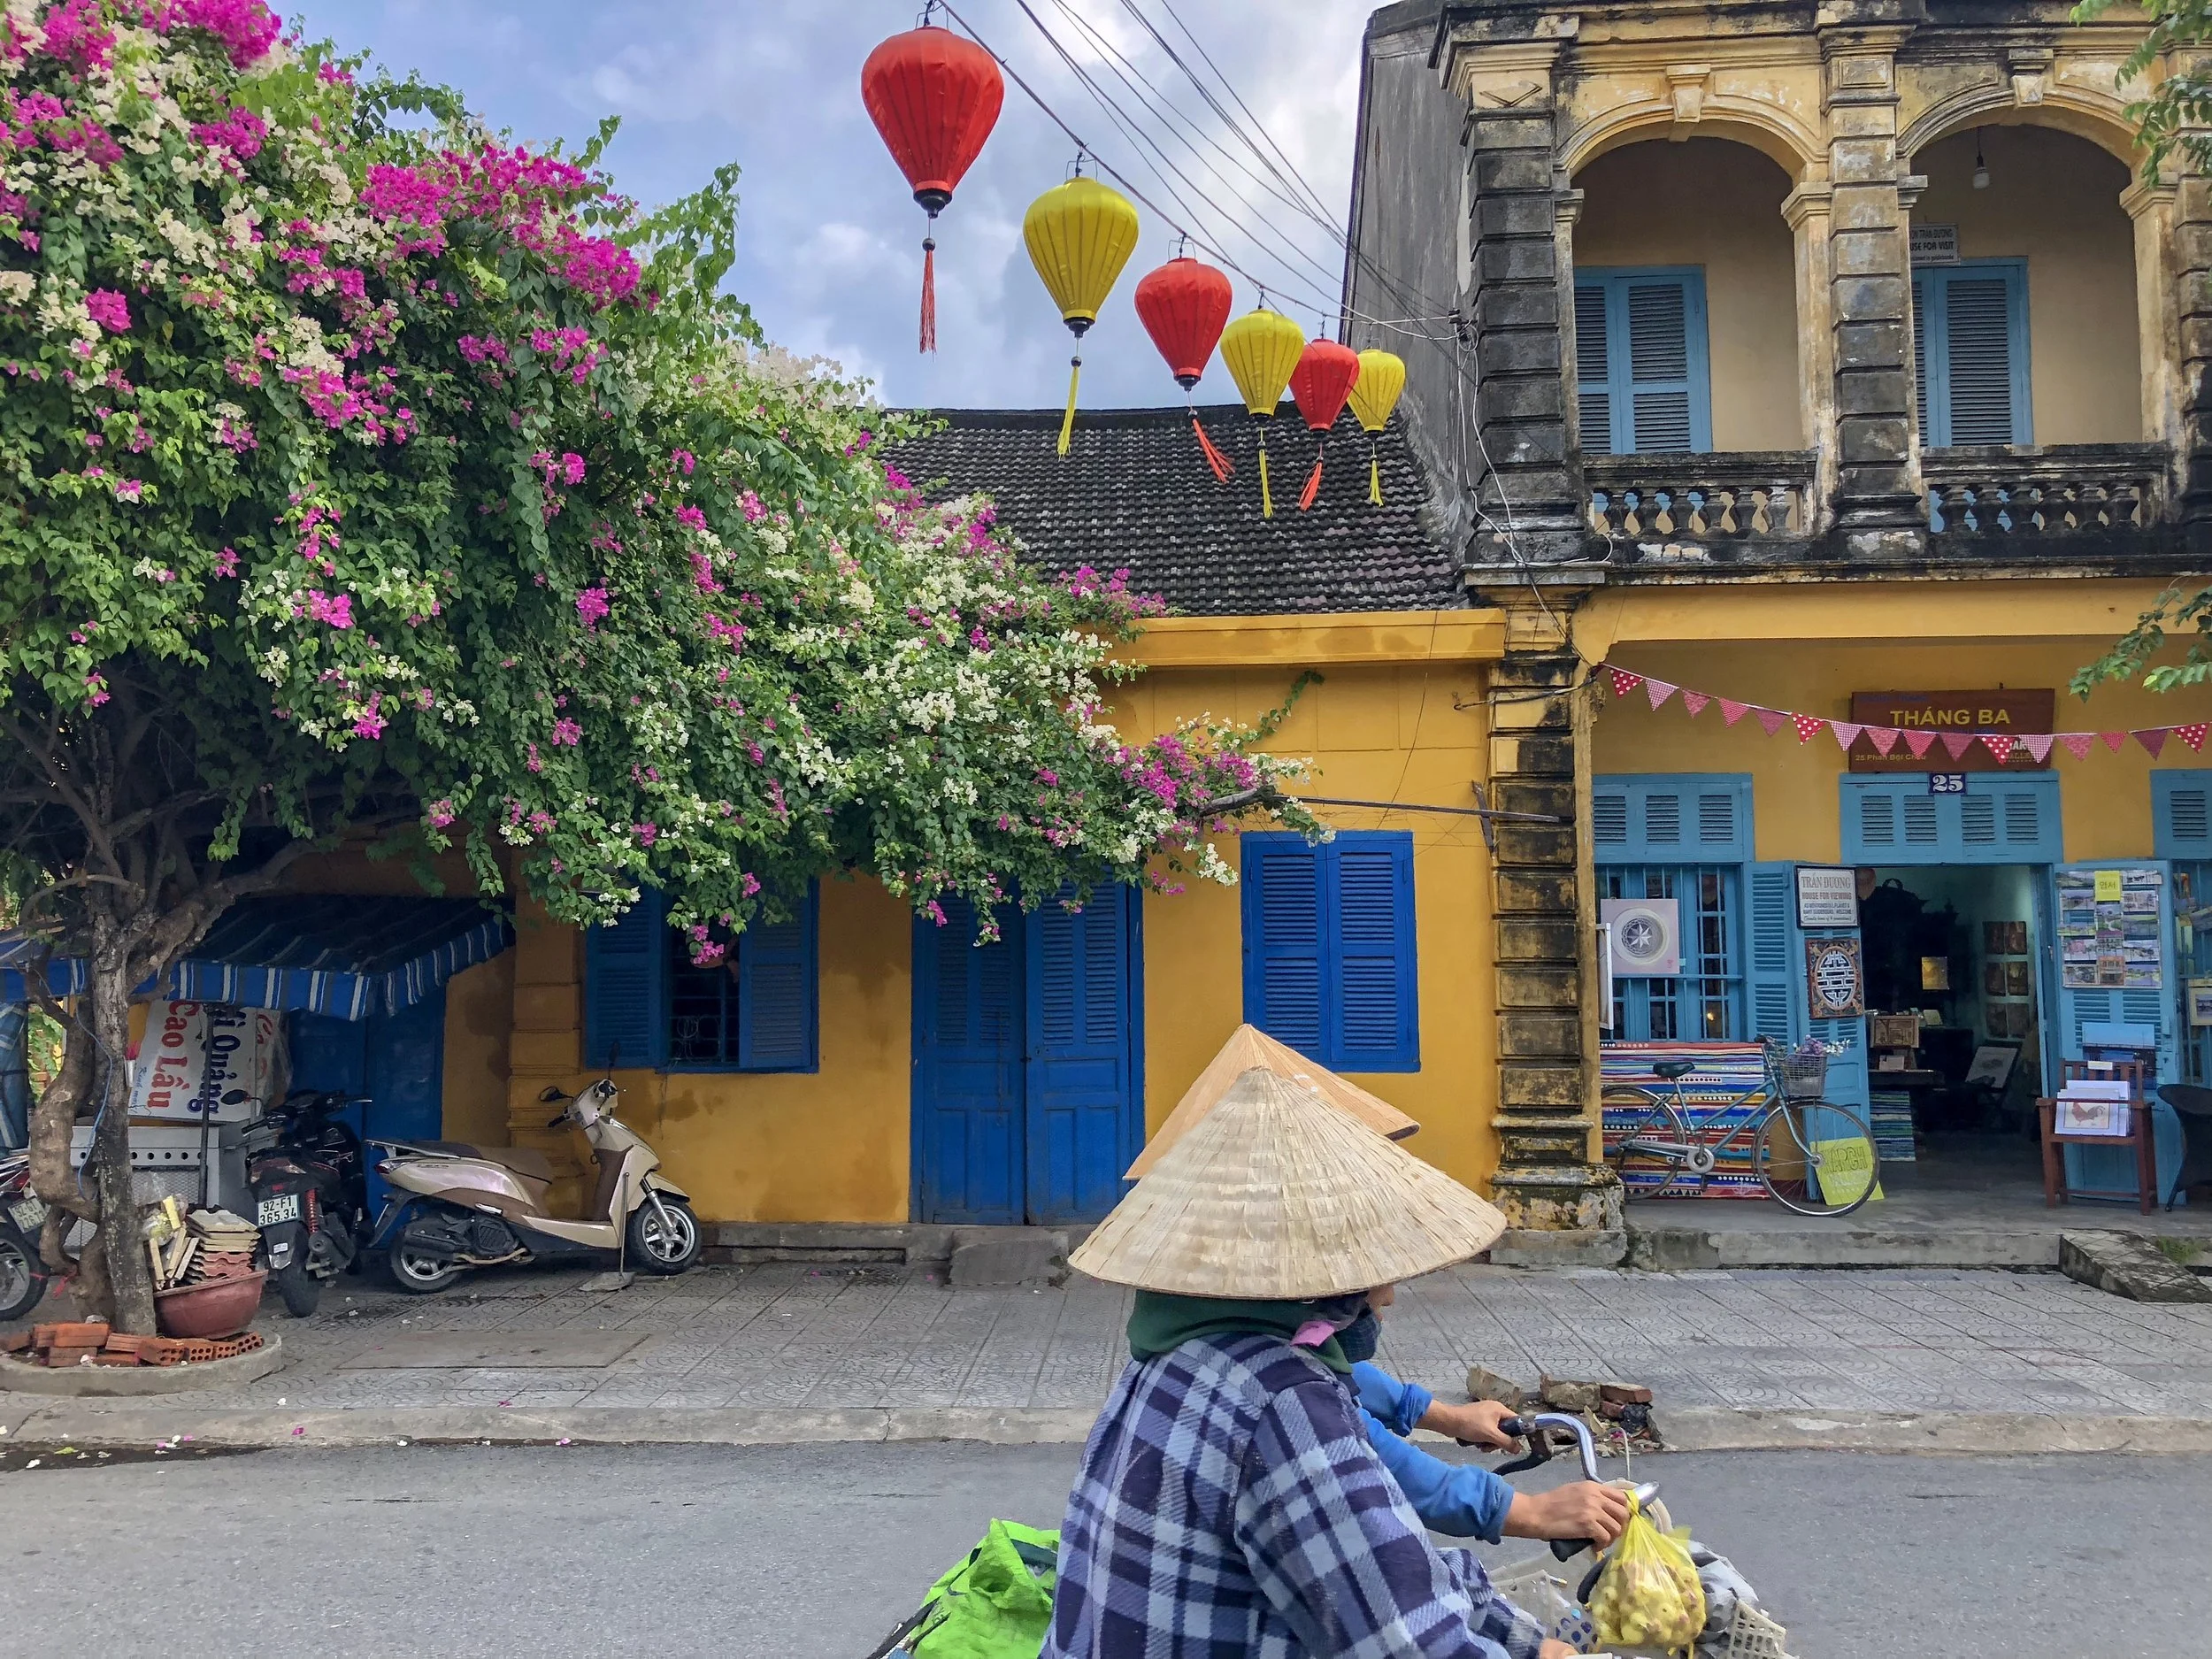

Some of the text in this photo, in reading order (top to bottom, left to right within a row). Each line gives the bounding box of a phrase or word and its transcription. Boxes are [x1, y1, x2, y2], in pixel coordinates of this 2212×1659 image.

[1923, 242, 1937, 250] FOR
[1938, 241, 1954, 250] VISIT
[1890, 706, 2010, 726] THÁNG BA
[1932, 774, 1963, 792] 25
[161, 1001, 201, 1048] Cao
[263, 1197, 292, 1213] 92-F1
[259, 1208, 297, 1225] 365.34
